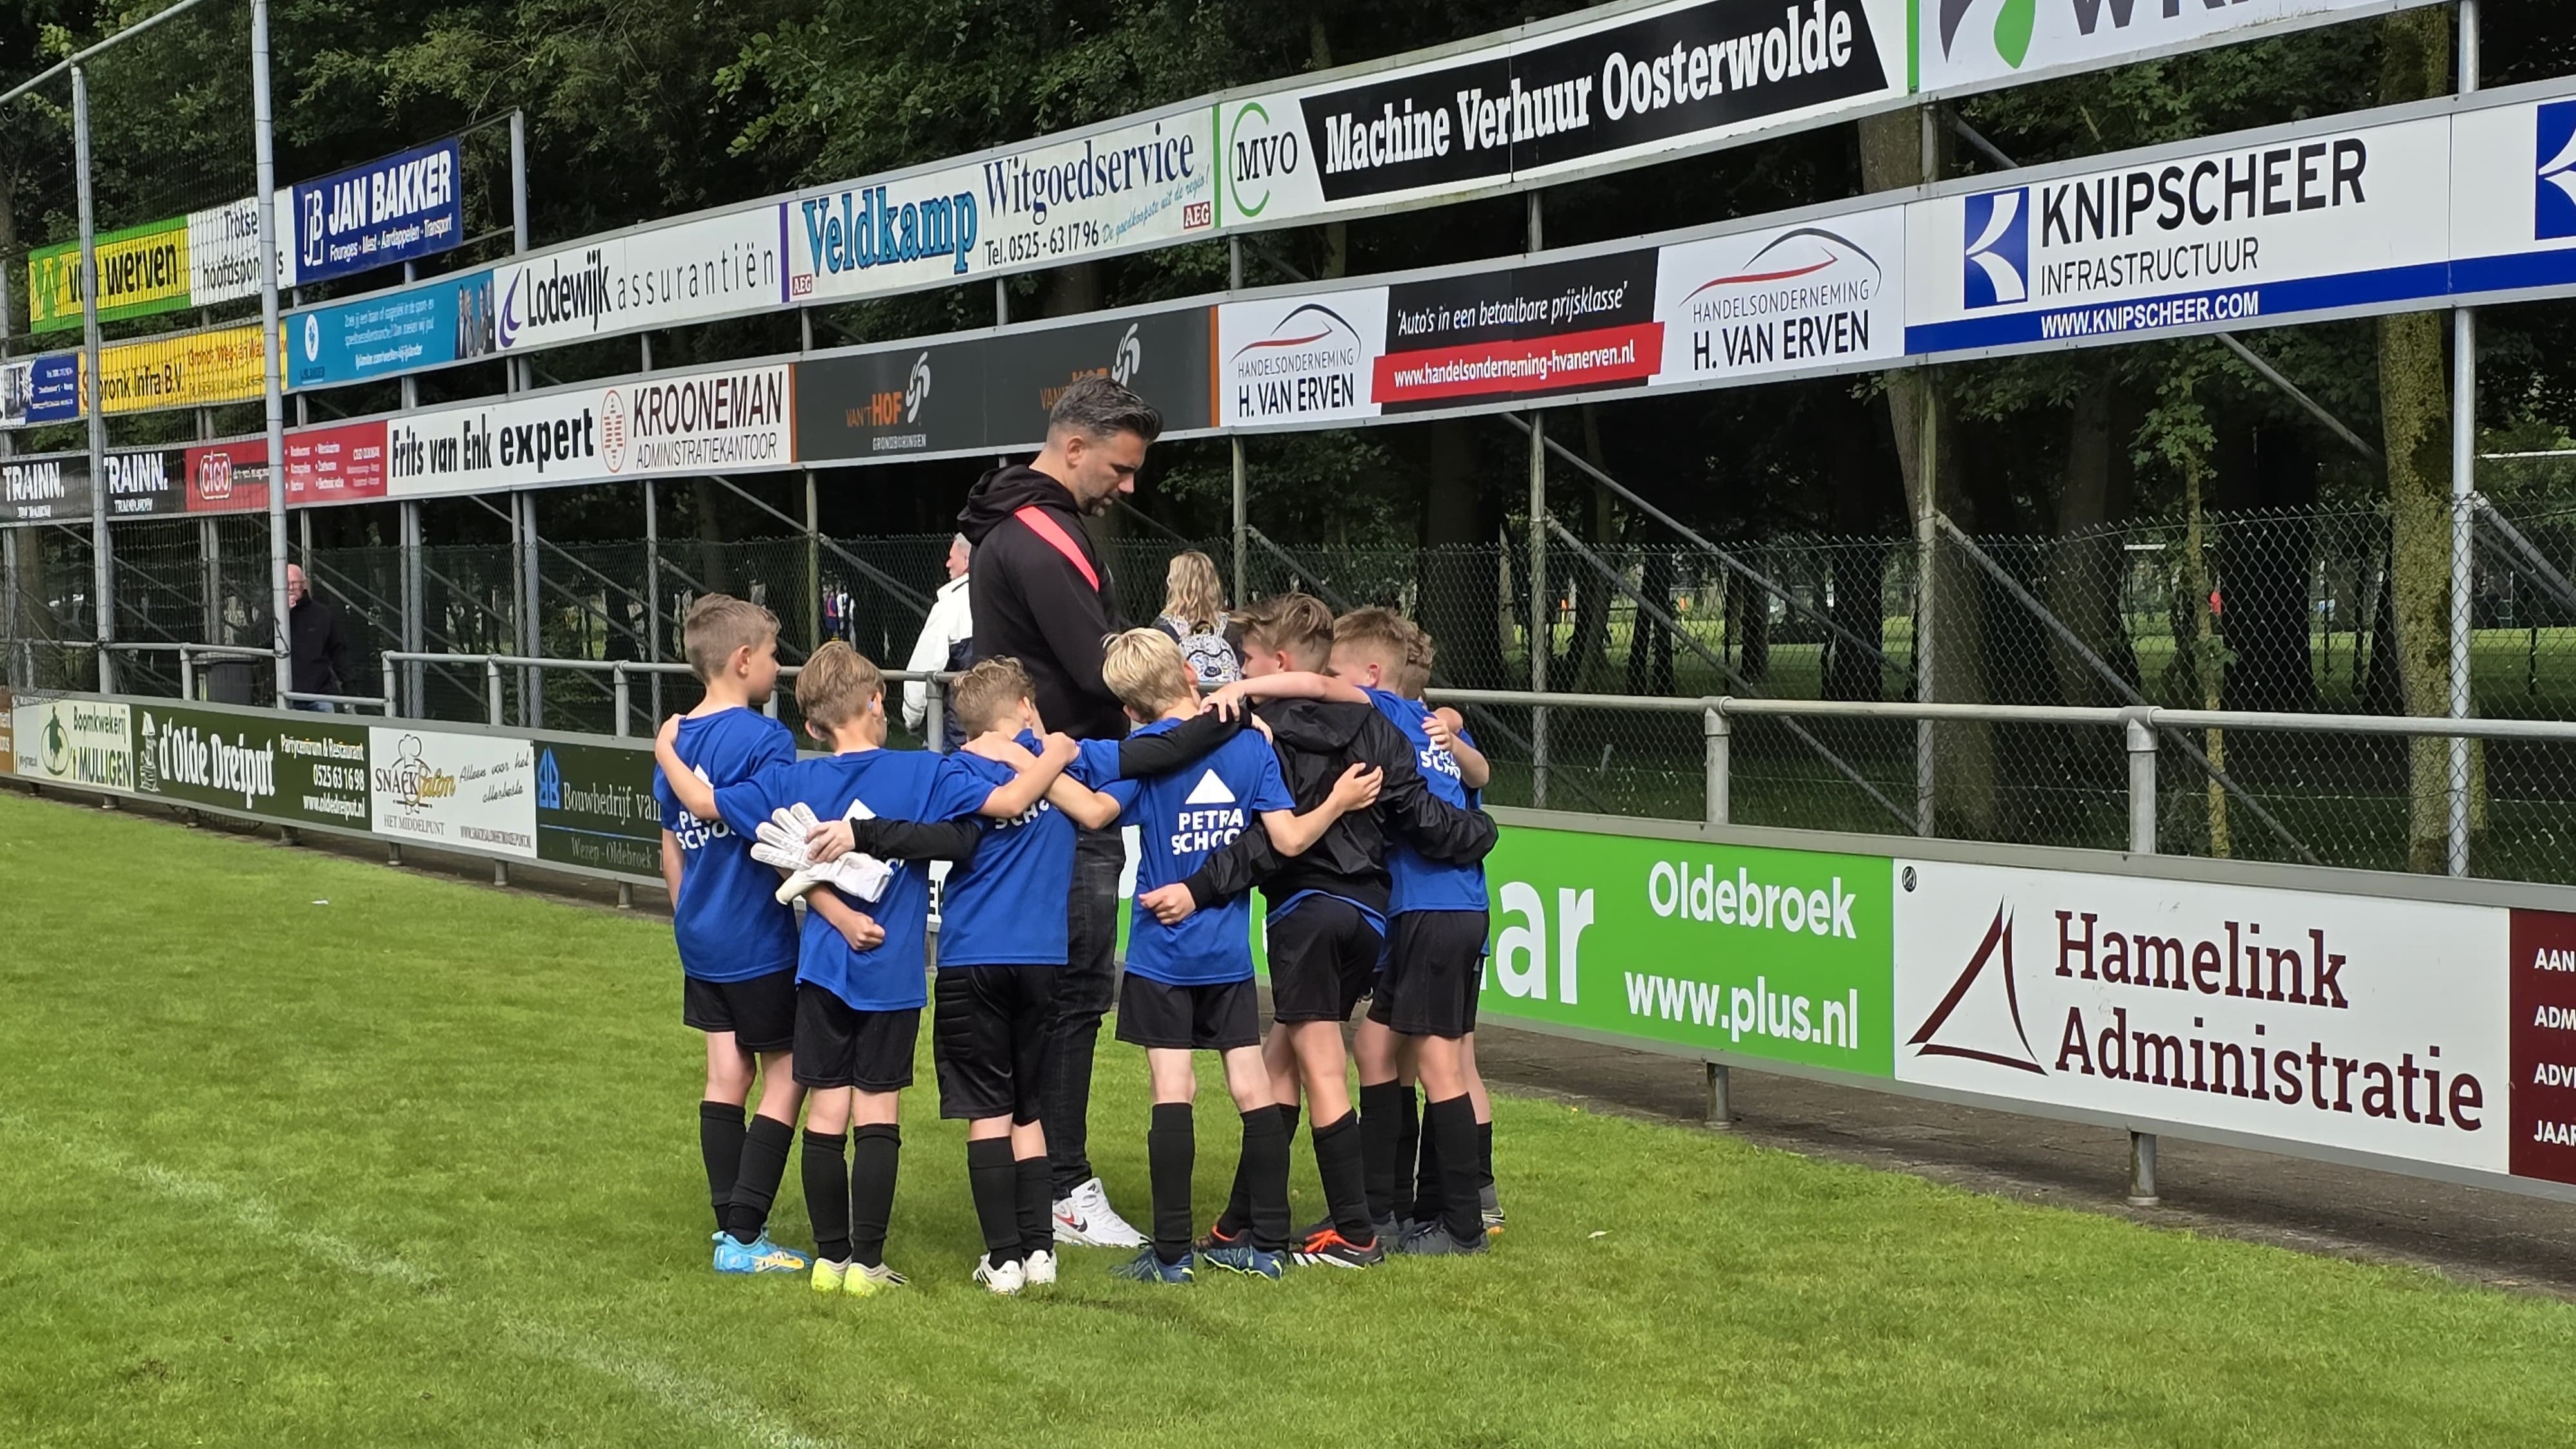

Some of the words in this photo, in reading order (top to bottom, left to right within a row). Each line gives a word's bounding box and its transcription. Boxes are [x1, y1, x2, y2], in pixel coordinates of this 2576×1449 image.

[1325, 98, 1450, 174] Machine
[1457, 75, 1593, 151] Verhuur
[1602, 0, 1852, 121] Oosterwolde
[983, 122, 1195, 225] Witgoedservice
[1236, 131, 1298, 182] MVO
[328, 176, 367, 236] JAN
[372, 150, 451, 224] BAKKER
[2041, 137, 2367, 247] KNIPSCHEER
[225, 208, 258, 242] Trotse
[802, 185, 978, 277] Veldkamp
[1184, 203, 1210, 227] AEG
[106, 243, 178, 296] werven
[985, 241, 1007, 266] Tel.
[1009, 231, 1039, 262] 0525
[2040, 236, 2259, 296] INFRASTRUCTUUR
[526, 248, 612, 332] Lodewijk
[618, 242, 774, 310] assurantiën
[793, 276, 812, 294] AEG
[1693, 279, 1869, 323] HANDELSONDERNEMING
[1438, 305, 1450, 332] in
[1453, 307, 1475, 330] een
[1479, 298, 1547, 327] betaalbare
[2041, 290, 2259, 339] WWW.KNIPSCHEER.COM
[1694, 330, 1717, 370] H.
[1722, 322, 1774, 366] VAN
[1783, 309, 1868, 360] ERVEN
[134, 366, 161, 396] Infra
[165, 362, 184, 395] B.V.
[1238, 348, 1354, 379] HANDELSONDERNEMING
[1394, 339, 1635, 388] www.handelsonderneming-hvanerven.nl
[634, 370, 783, 439] KROONEMAN
[871, 391, 902, 426] HOF
[1239, 384, 1255, 417] H.
[1258, 379, 1292, 415] VAN
[1298, 372, 1354, 412] ERVEN
[392, 425, 424, 478] Frits
[430, 437, 457, 475] van
[463, 413, 492, 471] Enk
[500, 408, 594, 473] expert
[636, 432, 777, 469] ADMINISTRATIEKANTOOR
[3, 461, 64, 502] TRAINN.
[73, 705, 126, 744] Boomkwekerij
[79, 746, 131, 788] MULLIGEN
[160, 717, 209, 787] d'Olde
[211, 733, 275, 809] Dreiput
[313, 764, 332, 788] 0525
[332, 766, 342, 789] 63
[344, 768, 354, 791] 16
[354, 768, 365, 791] 98
[375, 768, 419, 795] SNACK
[384, 814, 397, 829] HET
[398, 815, 445, 836] MIDDELPUNT
[563, 781, 632, 826] Bouwbedrijf
[636, 793, 662, 822] van
[1179, 808, 1244, 831] PETRA
[571, 835, 600, 866] Wezep
[605, 842, 652, 869] Oldebroek
[1648, 860, 1857, 939] Oldebroek
[2055, 910, 2349, 1009] Hamelink
[1624, 976, 1858, 1050] www.plus.nl
[2055, 1007, 2483, 1132] Administratie
